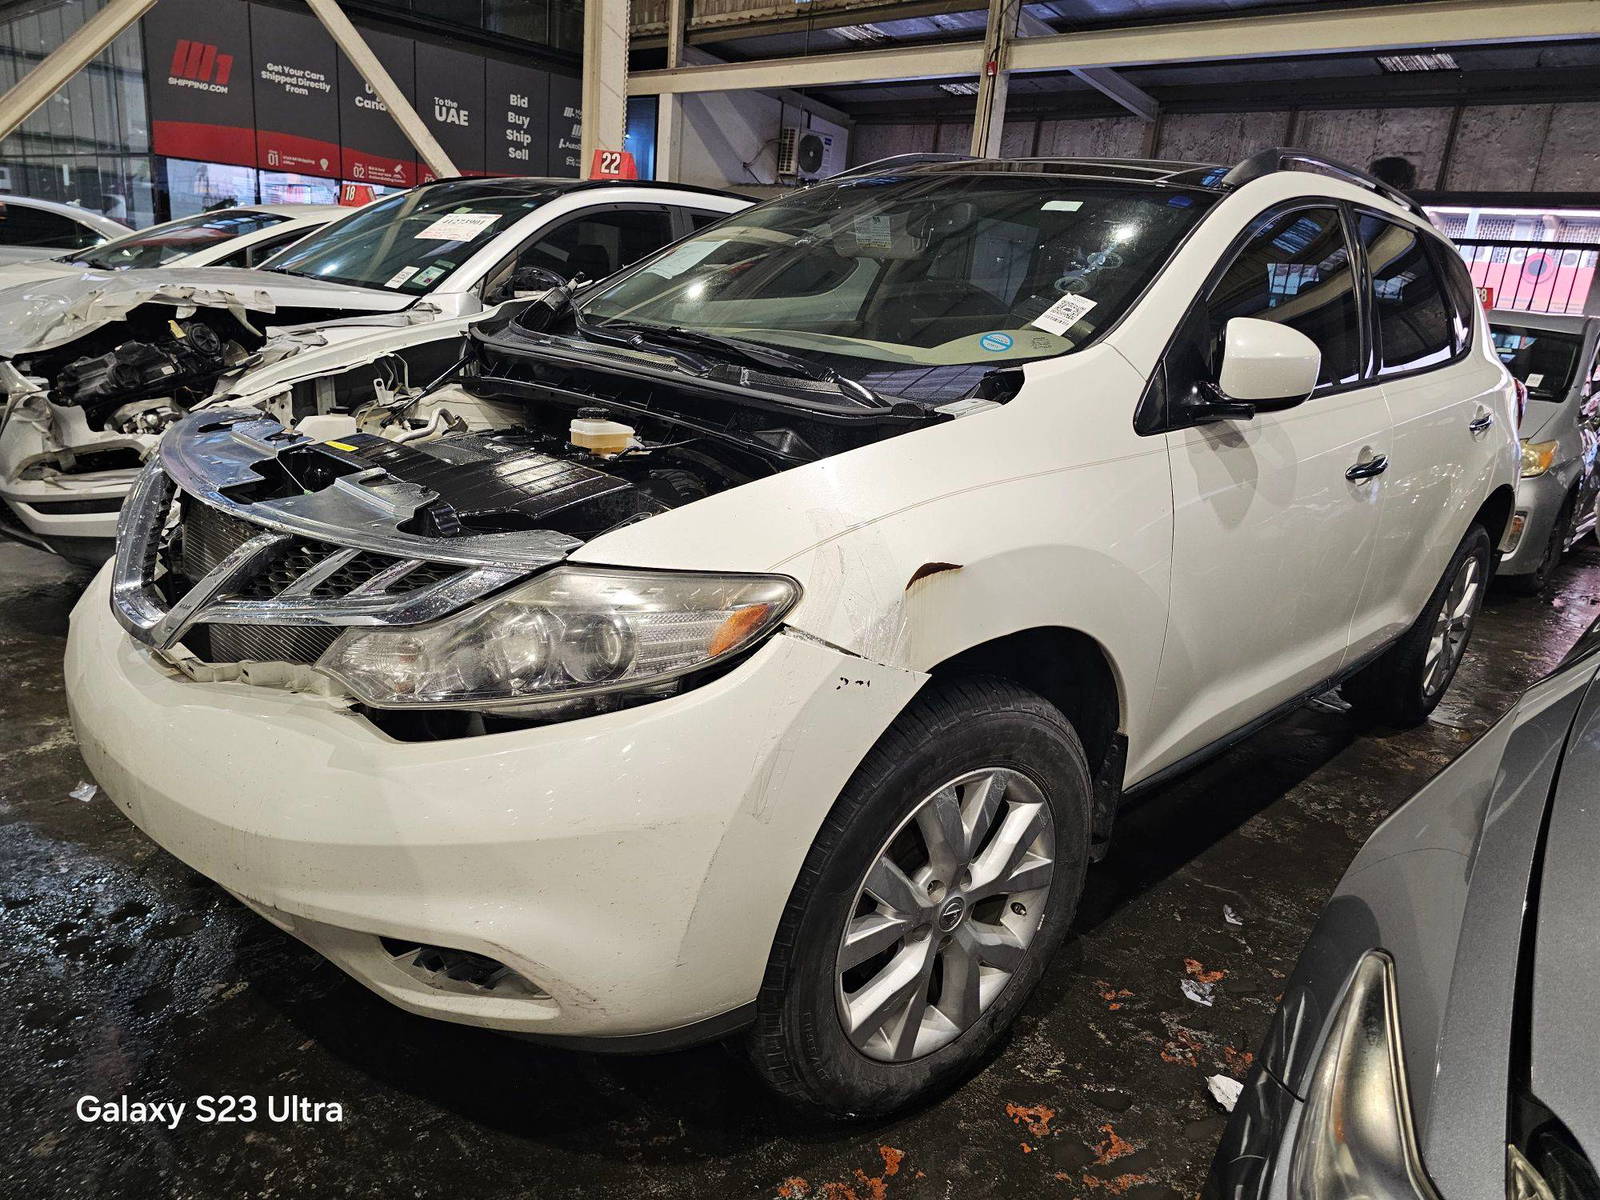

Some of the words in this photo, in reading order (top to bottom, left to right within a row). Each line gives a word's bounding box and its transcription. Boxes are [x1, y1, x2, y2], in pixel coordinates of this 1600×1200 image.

[266, 62, 283, 73] Get
[283, 65, 304, 77] Your
[304, 70, 325, 81] Cars
[168, 77, 229, 94] SHIPPING.COM
[261, 70, 297, 84] Shipped
[297, 78, 331, 93] Directly
[285, 84, 309, 96] From
[355, 96, 387, 112] Cana
[434, 96, 445, 106] To
[444, 99, 459, 108] the
[510, 93, 529, 108] Bid
[434, 105, 470, 127] UAE
[507, 111, 531, 129] Buy
[505, 129, 532, 147] Ship
[267, 153, 279, 166] 01
[508, 147, 529, 161] Sell
[600, 152, 621, 174] 22
[353, 166, 365, 179] 02
[345, 185, 356, 201] 18
